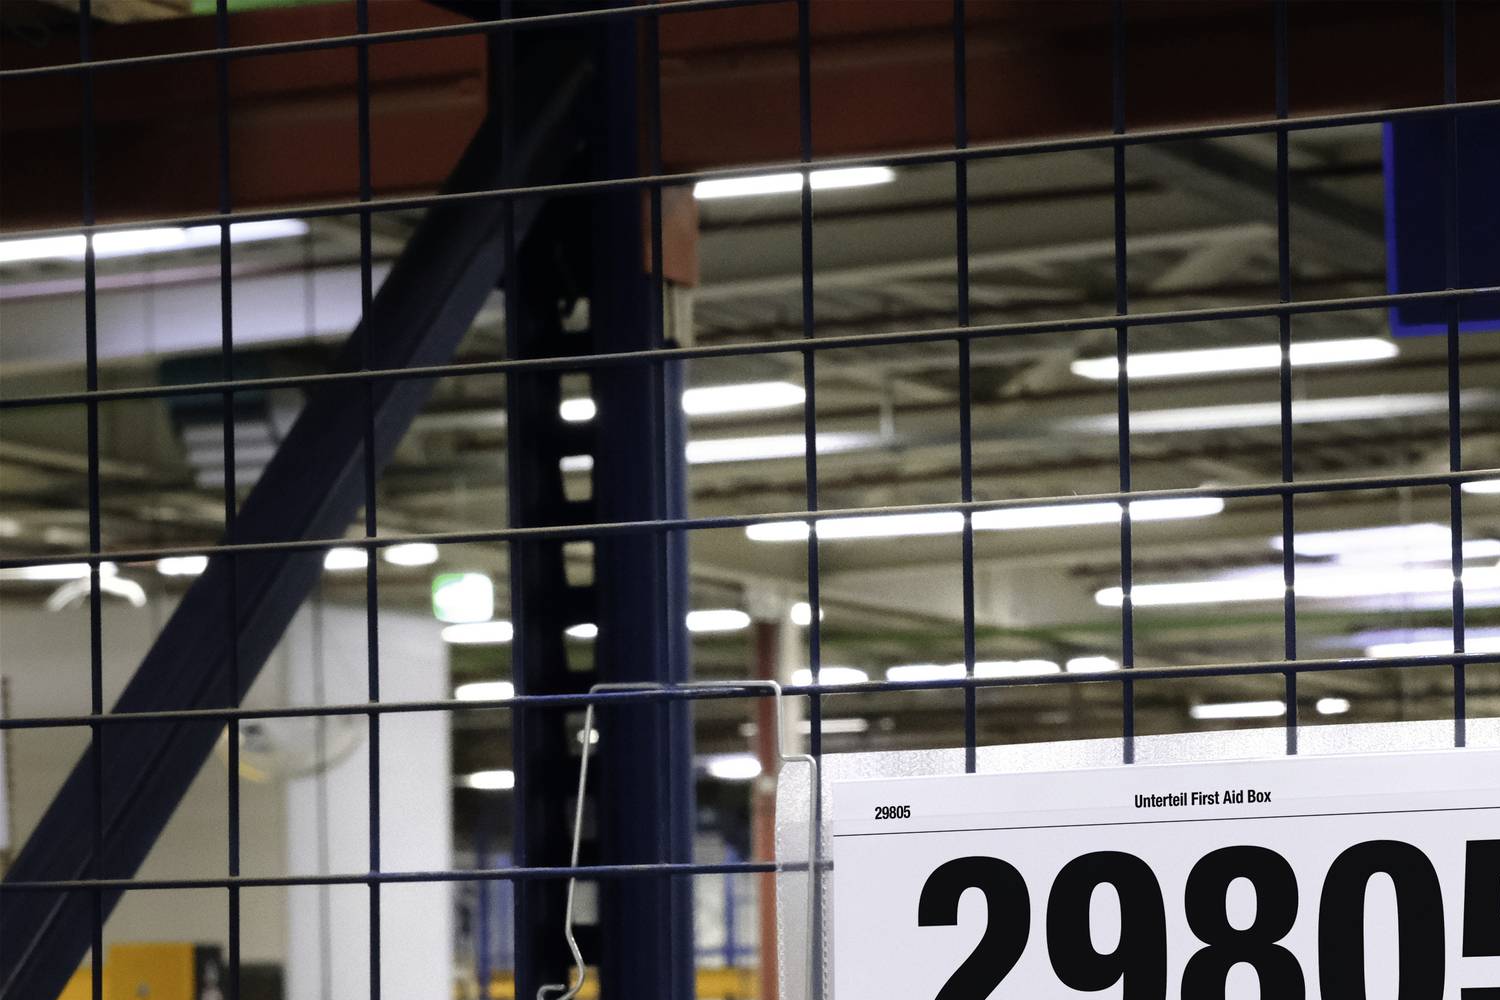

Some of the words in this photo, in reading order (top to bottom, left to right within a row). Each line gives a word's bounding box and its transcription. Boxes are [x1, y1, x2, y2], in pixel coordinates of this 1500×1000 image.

[1134, 793, 1188, 808] Unterteil
[1191, 791, 1219, 806] First
[1222, 790, 1244, 804] Aid
[1247, 789, 1272, 804] Box
[874, 805, 911, 820] 29805
